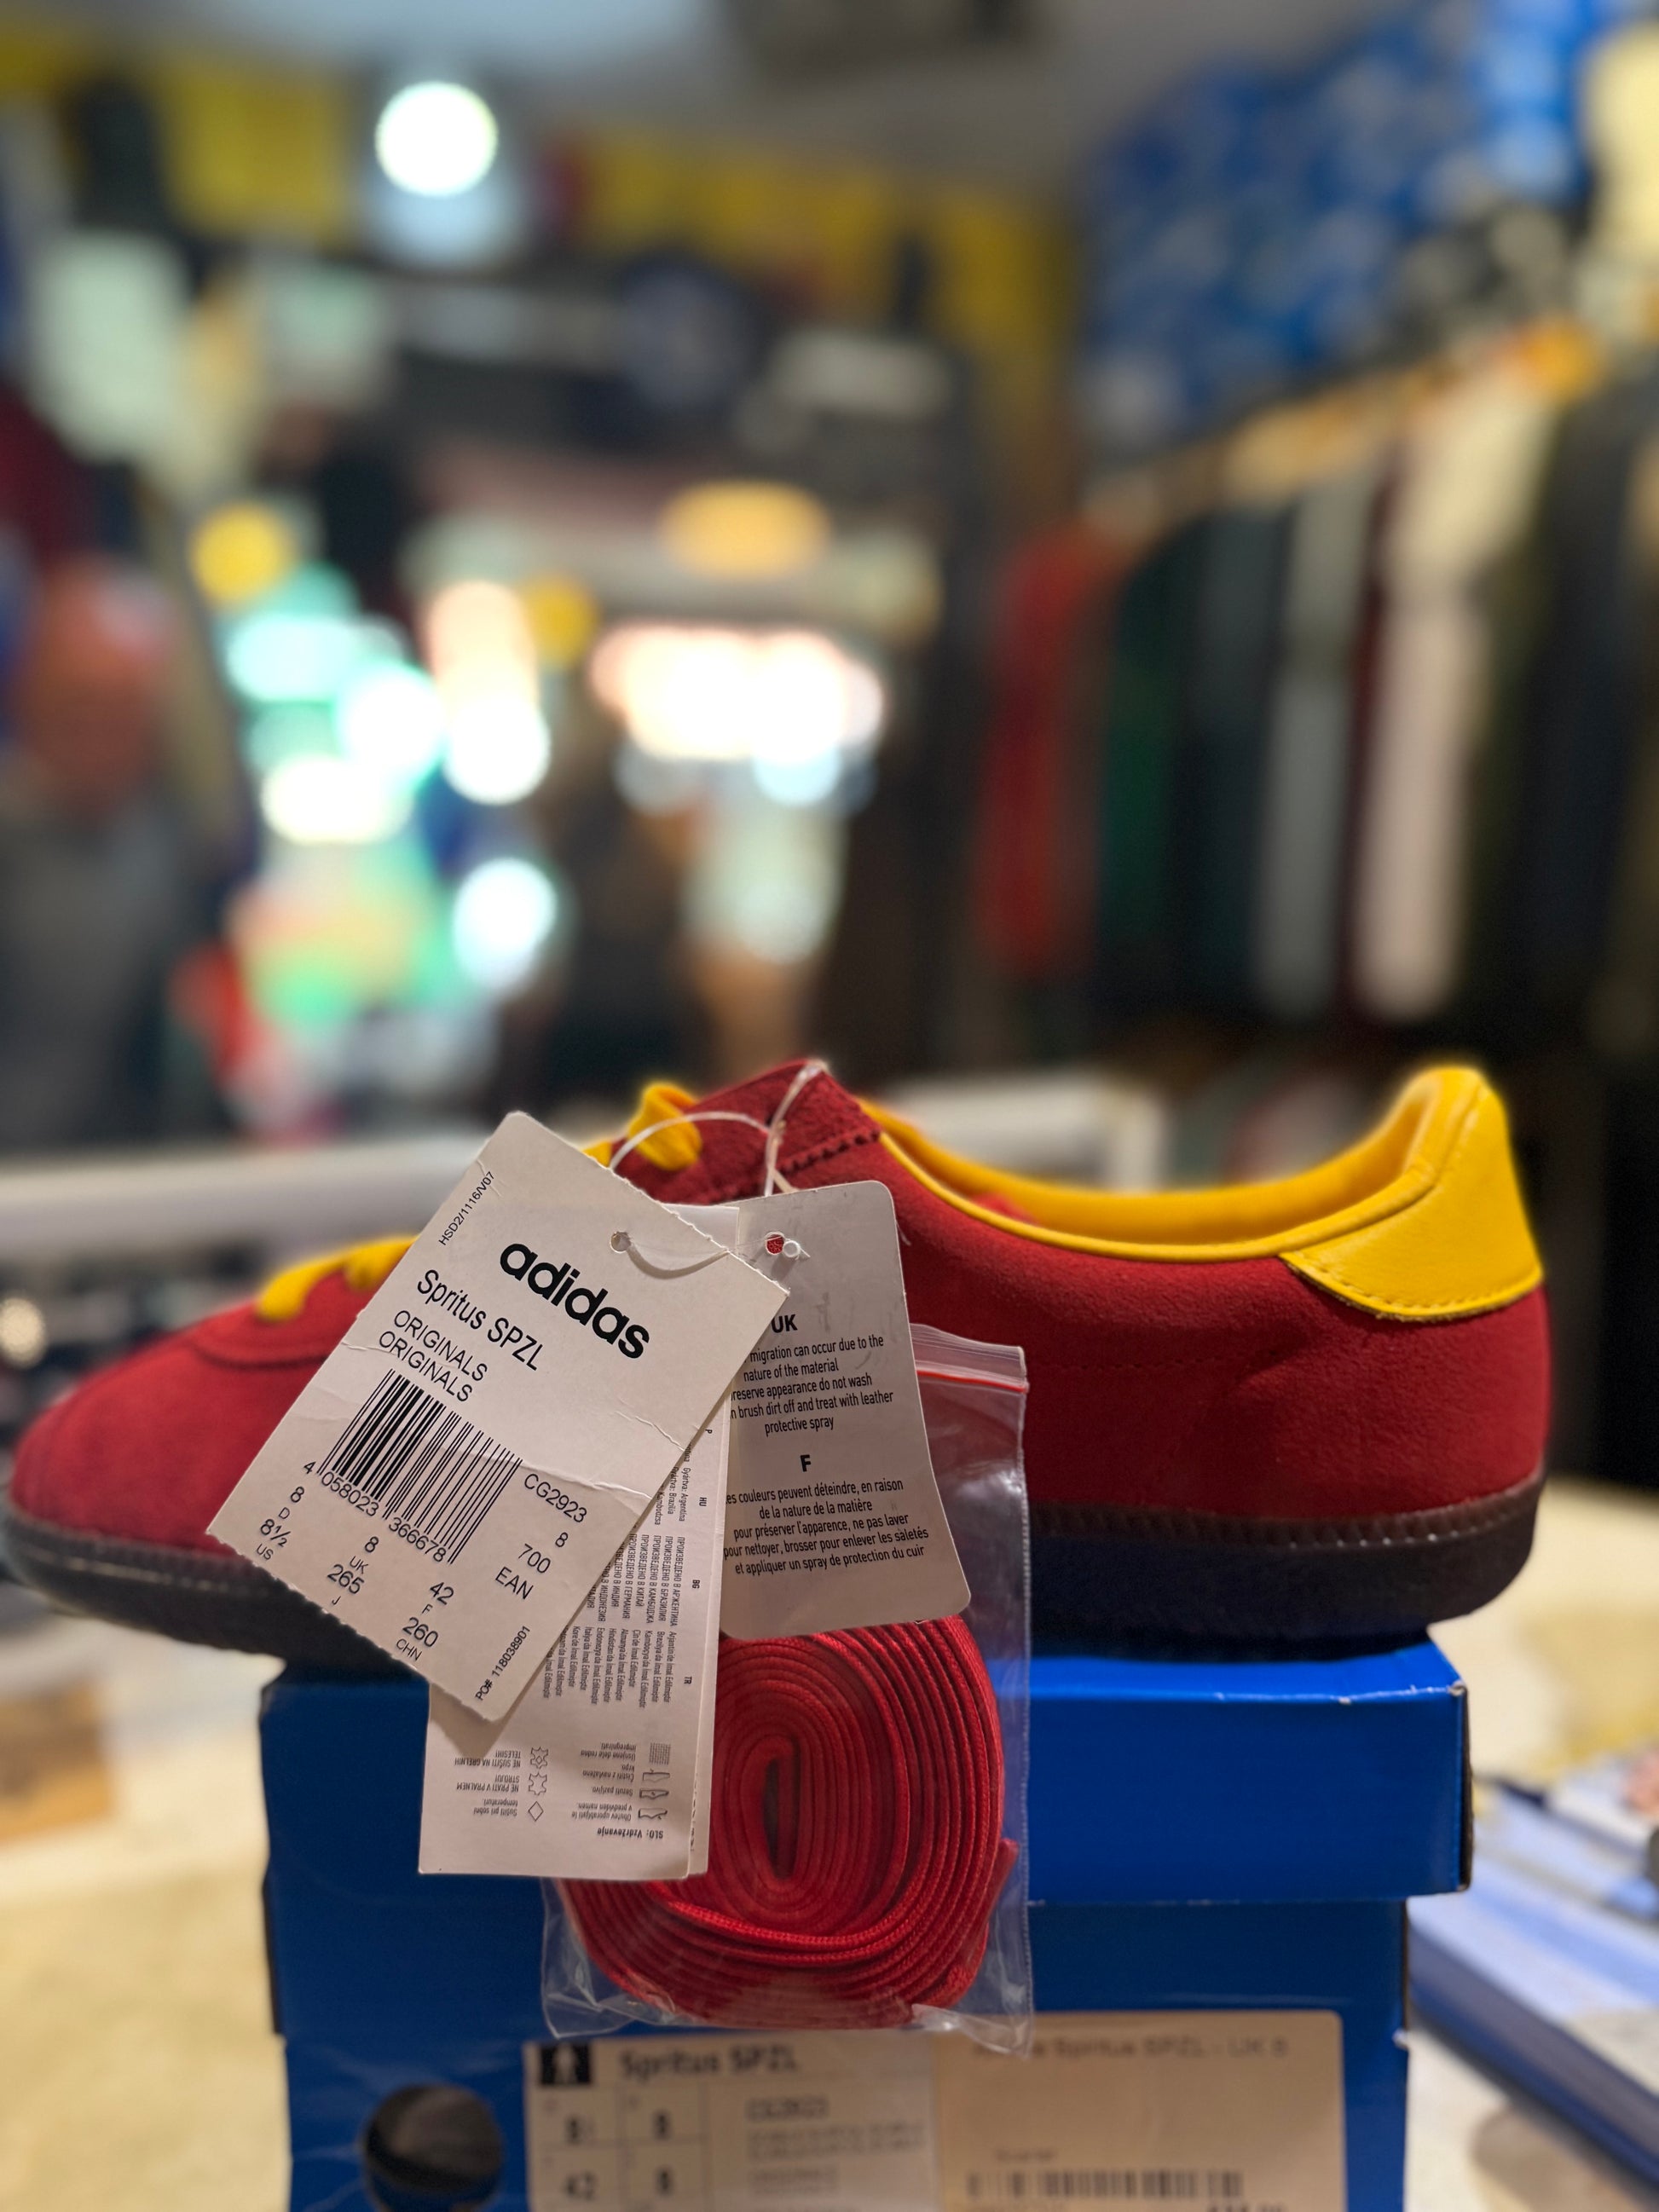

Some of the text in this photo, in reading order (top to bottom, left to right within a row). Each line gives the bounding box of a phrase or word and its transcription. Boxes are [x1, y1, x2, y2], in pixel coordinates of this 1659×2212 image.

[438, 1171, 494, 1245] HSD2/1116/V07
[500, 1244, 650, 1359] adidas
[418, 1270, 542, 1371] Spritus SPZL
[771, 1314, 798, 1333] UK
[394, 1310, 488, 1381] ORIGINALS
[750, 1335, 883, 1365] migration can occur due to the
[379, 1331, 472, 1401] ORIGINALS
[743, 1358, 839, 1381] nature of the material
[766, 1382, 817, 1399] appearance
[819, 1377, 830, 1390] do
[832, 1377, 846, 1389] not
[848, 1372, 872, 1387] wash
[738, 1403, 764, 1418] brush
[766, 1402, 782, 1415] dirt
[783, 1400, 795, 1413] off
[798, 1397, 813, 1412] and
[816, 1396, 837, 1410] treat
[840, 1393, 858, 1406] with
[860, 1390, 893, 1405] leather
[765, 1417, 834, 1436] protective spray
[801, 1454, 811, 1471] F
[290, 1487, 304, 1503] 8
[524, 1474, 587, 1522] CG2923
[699, 1497, 706, 1506] HU
[738, 1489, 776, 1503] couleurs
[777, 1485, 812, 1502] peuvent
[814, 1481, 859, 1496] déteindre,
[861, 1483, 872, 1493] en
[875, 1478, 904, 1492] raison
[278, 1507, 290, 1519] D
[321, 1472, 379, 1516] 058023
[389, 1520, 447, 1562] 366678
[760, 1499, 872, 1519] de la nature de la matière
[555, 1533, 568, 1547] 8
[724, 1526, 928, 1560] pour nettoyer, brosser pour enlever les saletés
[734, 1528, 752, 1542] pour
[755, 1523, 795, 1540] préserver
[853, 1520, 864, 1529] ne
[866, 1517, 883, 1530] pas
[885, 1514, 908, 1526] laver
[256, 1544, 273, 1560] US
[365, 1536, 379, 1553] 8
[518, 1544, 551, 1574] 700
[637, 1533, 649, 1580] ПРОИЗВЕДЕНО
[649, 1534, 661, 1580] ПРОИЗВЕДЕНО
[661, 1535, 673, 1580] ПРОИЗВЕДЕНО
[673, 1536, 685, 1581] ПРОИЗВЕДЕНО
[350, 1556, 368, 1574] UK
[735, 1545, 924, 1575] et appliquer un spray de protection du cuir
[327, 1564, 364, 1594] 265
[430, 1582, 454, 1605] 42
[495, 1567, 534, 1599] EAN
[691, 1580, 700, 1588] BG
[332, 1596, 341, 1605] J
[422, 1604, 433, 1614] F
[598, 1585, 608, 1621] ИНДОНЕЗИЯ
[610, 1585, 620, 1607] ИНДИЯ
[621, 1585, 632, 1619] ГЕРМАНИЯ
[635, 1586, 645, 1607] КИТАЙ
[645, 1587, 656, 1623] КАМБОДЖА
[658, 1588, 668, 1621] БРАЗИЛИЯ
[670, 1588, 680, 1626] АРЖЕНТИНА
[402, 1617, 438, 1647] 260
[396, 1638, 422, 1660] CHN
[476, 1626, 530, 1701] PO# 118038901
